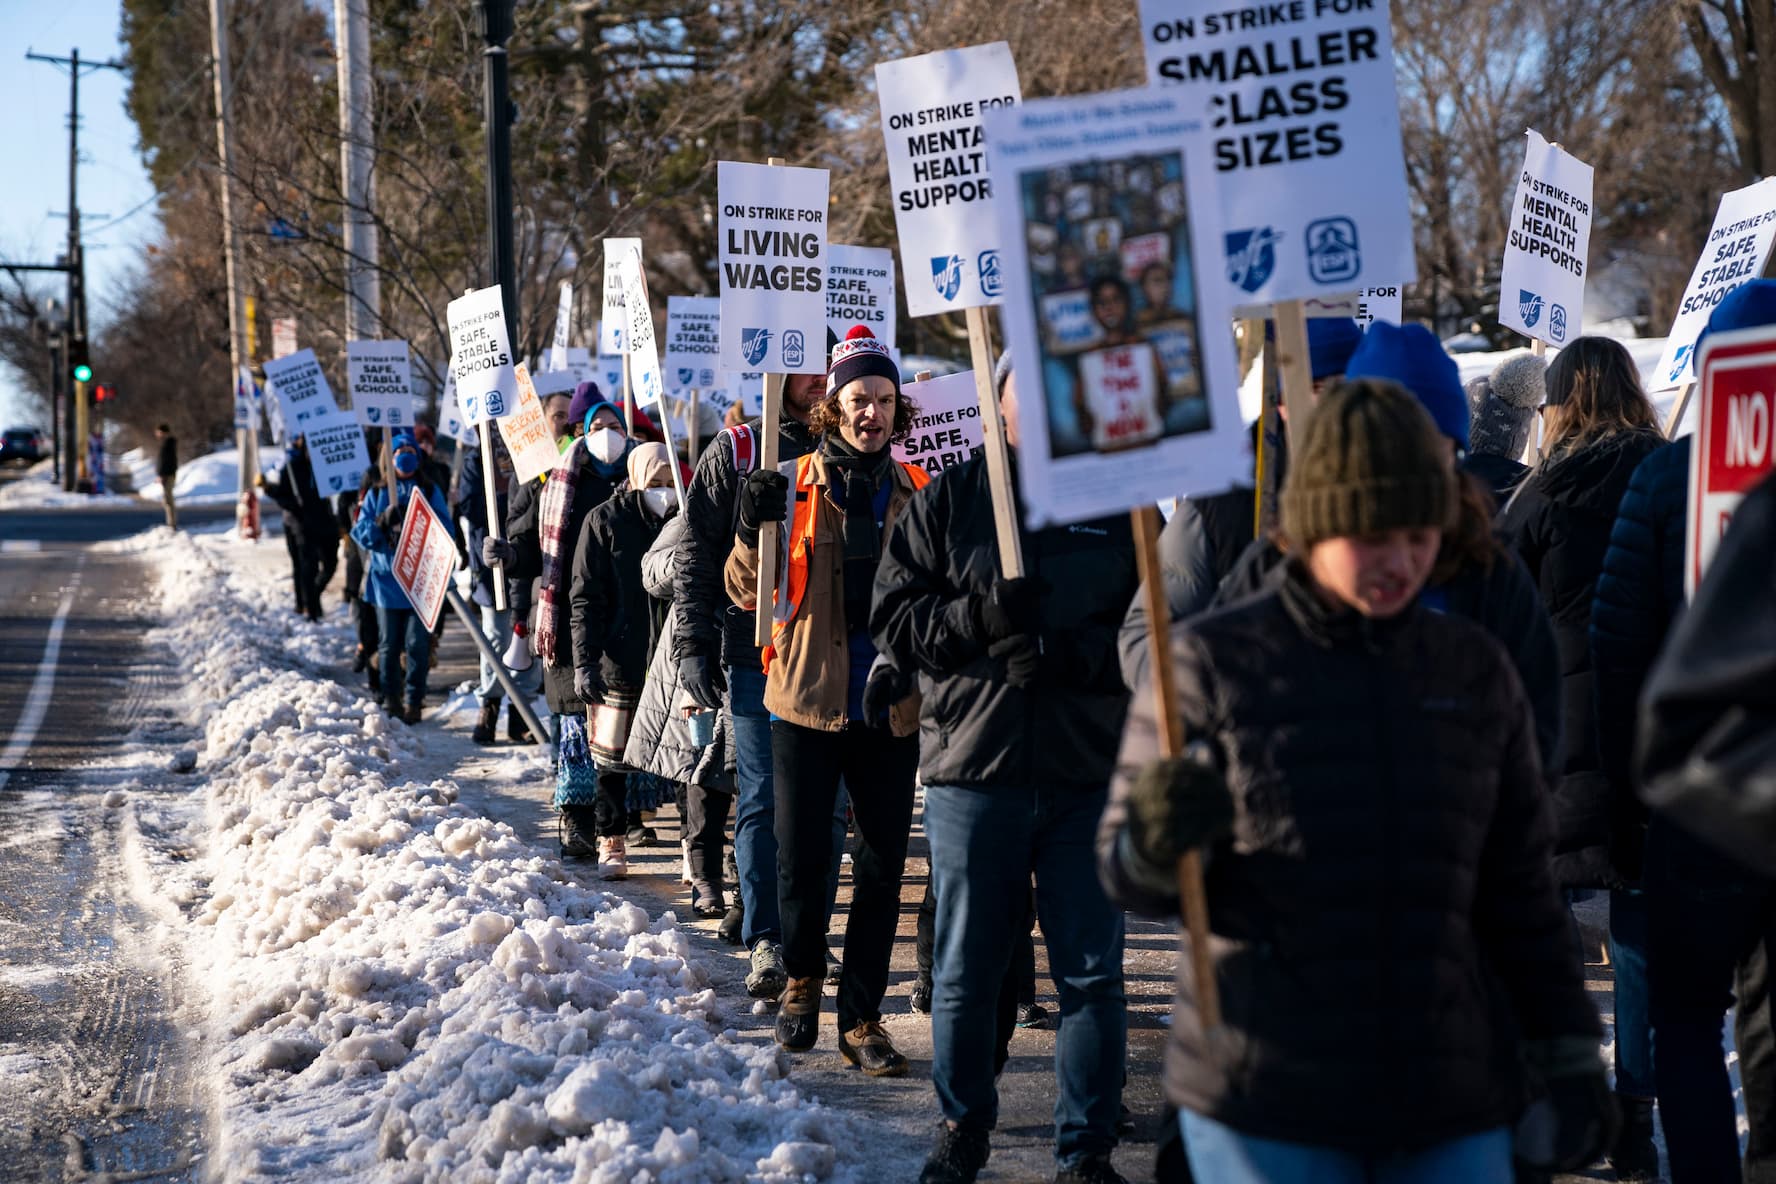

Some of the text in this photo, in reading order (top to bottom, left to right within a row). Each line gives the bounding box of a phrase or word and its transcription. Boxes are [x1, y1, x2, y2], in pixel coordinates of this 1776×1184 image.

[1153, 17, 1195, 43] ON
[1203, 1, 1304, 36] STRIKE
[1158, 26, 1378, 84] SMALLER
[889, 112, 914, 130] ON
[918, 102, 974, 125] STRIKE
[908, 125, 985, 157] MENTA
[1214, 122, 1344, 173] SIZES
[913, 152, 990, 183] HEALT
[899, 178, 993, 211] SUPPOR
[1522, 171, 1588, 216] ON STRIKE FOR
[724, 204, 823, 223] ON STRIKE FOR
[1523, 193, 1578, 234] MENTAL
[1522, 214, 1576, 252] HEALTH
[1711, 227, 1727, 242] ON
[1727, 215, 1762, 237] STRIKE
[728, 228, 819, 259] LIVING
[1510, 230, 1583, 276] SUPPORTS
[1713, 234, 1757, 263] SAFE,
[724, 263, 822, 293] WAGES
[830, 266, 887, 277] STRIKE FOR
[1698, 255, 1758, 289] STABLE
[827, 278, 871, 294] SAFE,
[1368, 287, 1397, 297] FOR
[826, 292, 877, 307] TABLE
[484, 310, 500, 320] FOR
[460, 327, 490, 346] SAFE,
[669, 343, 720, 354] SCHOOL
[675, 333, 719, 343] STABLE
[458, 340, 498, 363] STABLE
[274, 368, 319, 388] SMALLER
[457, 353, 509, 379] SCHOOLS
[284, 378, 316, 395] CLASS
[354, 385, 409, 394] SCHOOLS
[359, 375, 402, 384] STABLE
[290, 387, 318, 402] SIZES
[311, 431, 360, 448] SMALLER
[904, 428, 970, 456] SAFE,
[1725, 391, 1769, 469] NO
[320, 441, 356, 456] CLASS
[325, 451, 356, 465] SIZES
[400, 509, 428, 580] NO PARKING
